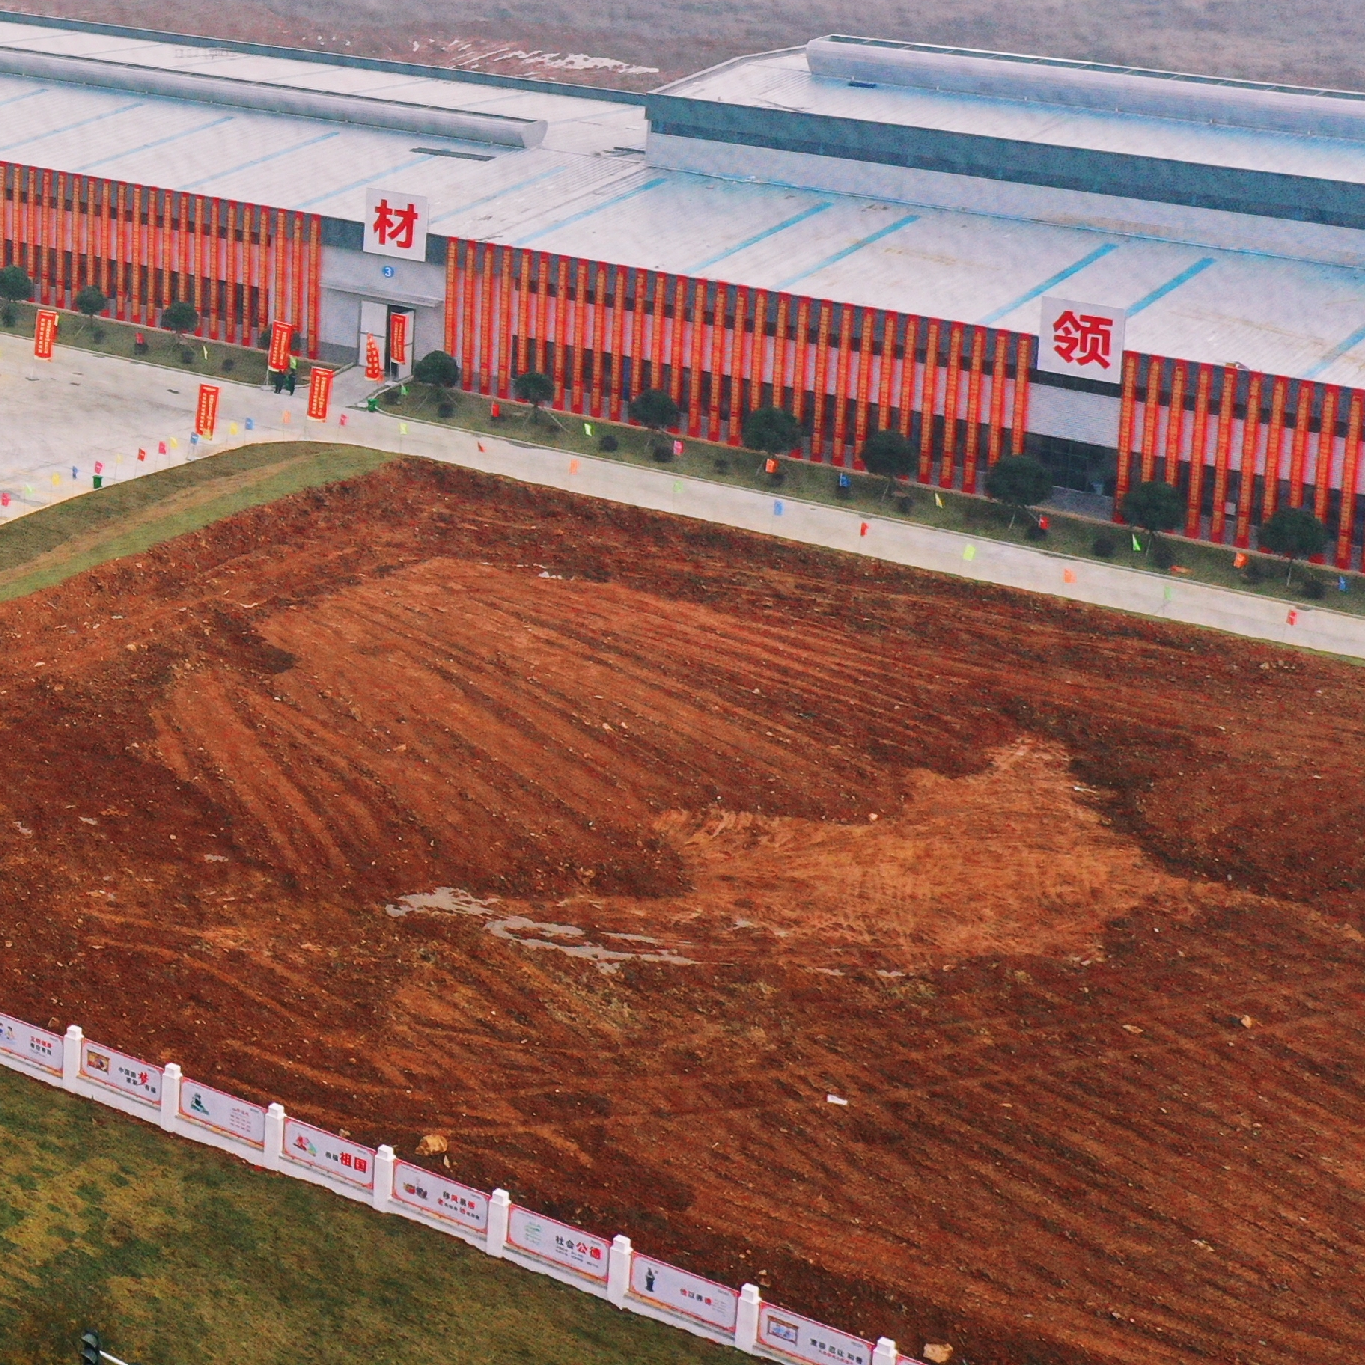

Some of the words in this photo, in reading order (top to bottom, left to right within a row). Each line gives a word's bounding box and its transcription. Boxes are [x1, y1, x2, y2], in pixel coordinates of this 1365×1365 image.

[373, 199, 418, 248] 材
[384, 267, 391, 276] 3
[1053, 310, 1113, 369] 领
